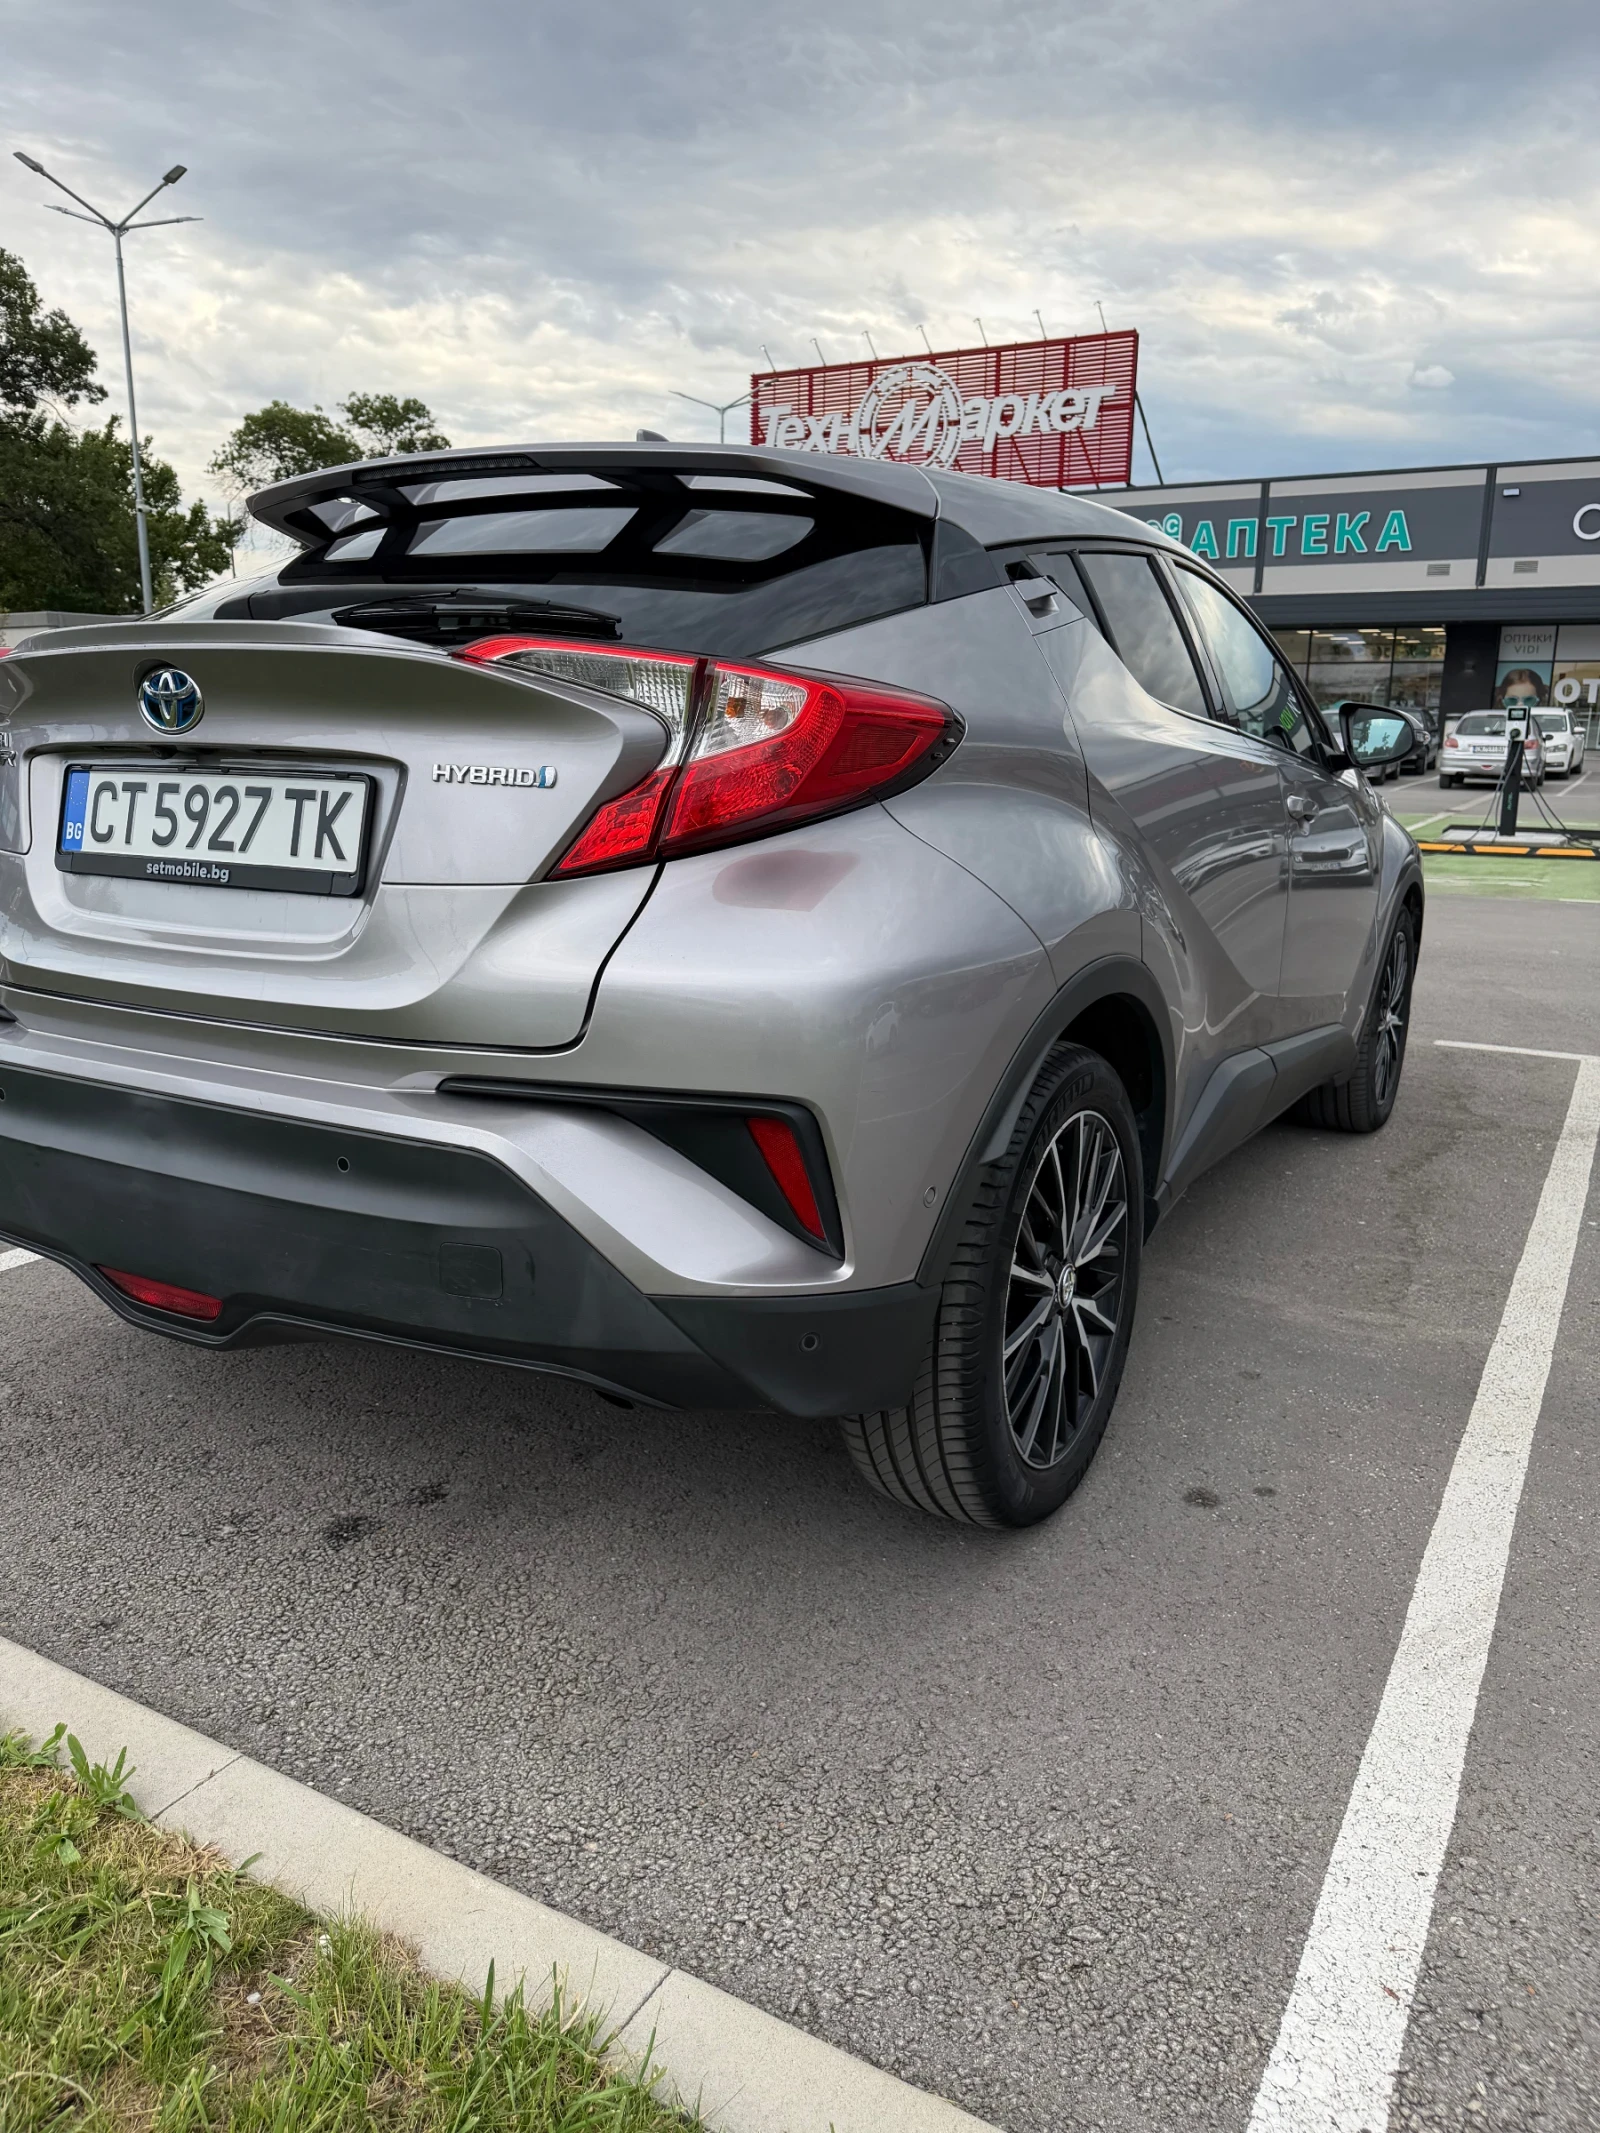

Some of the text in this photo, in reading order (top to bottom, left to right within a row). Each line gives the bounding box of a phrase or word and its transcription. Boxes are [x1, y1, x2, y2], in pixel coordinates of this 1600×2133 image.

[1190, 510, 1413, 559] АПТЕКА
[1504, 633, 1552, 644] ОПТИКИ
[1515, 645, 1540, 655] VIDI
[432, 764, 536, 788] HYBRID
[65, 821, 83, 840] BG
[285, 788, 353, 861] TK
[146, 861, 230, 882] setmobile.bg
